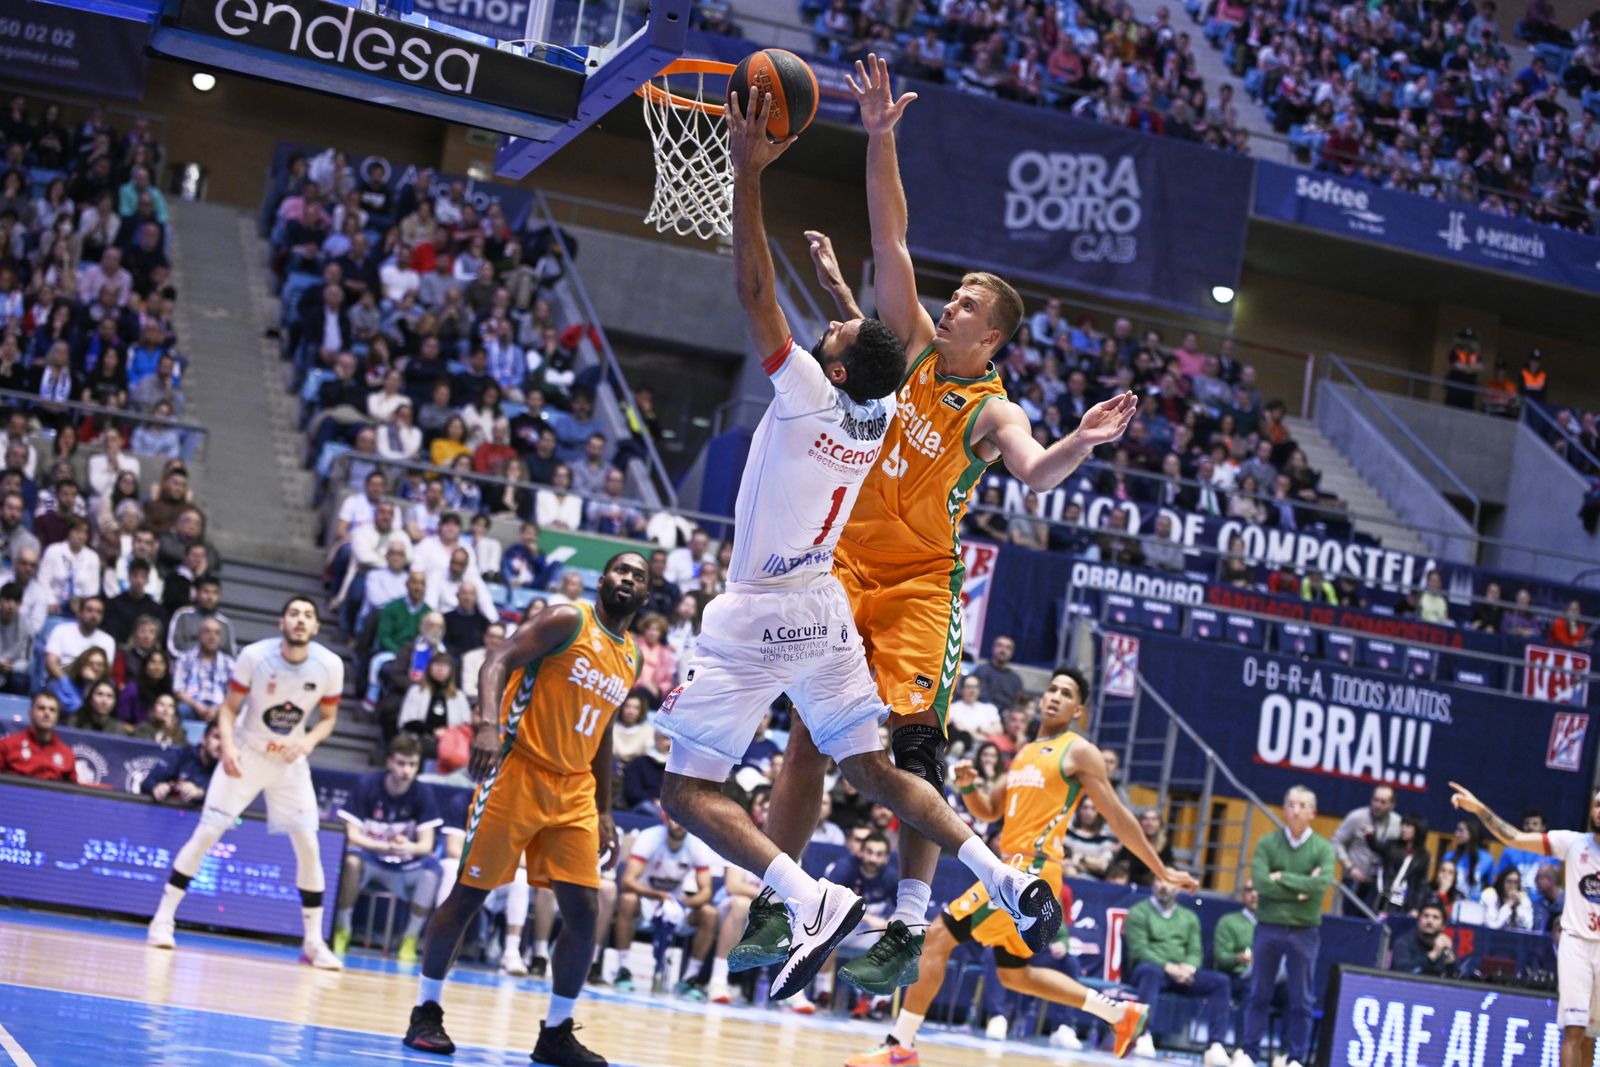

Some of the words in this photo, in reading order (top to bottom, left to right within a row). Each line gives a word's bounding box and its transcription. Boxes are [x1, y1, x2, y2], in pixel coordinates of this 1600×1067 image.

[25, 22, 48, 43] 02
[52, 27, 76, 48] 02
[215, 0, 480, 94] endesa
[1008, 151, 1141, 199] OBRA
[1296, 174, 1369, 211] Softee
[1004, 191, 1142, 233] DOIRO
[1071, 233, 1137, 263] CAB
[881, 441, 909, 479] 5
[813, 486, 847, 545] 1
[1072, 563, 1204, 605] OBRADOIRO
[760, 645, 787, 654] UNHA
[762, 628, 773, 642] A
[571, 656, 630, 704] Sevilla
[917, 679, 929, 688] acb
[1331, 672, 1386, 710] TODOS
[574, 704, 601, 736] 11
[1257, 693, 1432, 788] OBRA!!!
[1008, 793, 1018, 816] 1
[1347, 998, 1436, 1067] SAE
[1442, 992, 1499, 1067] AÍ
